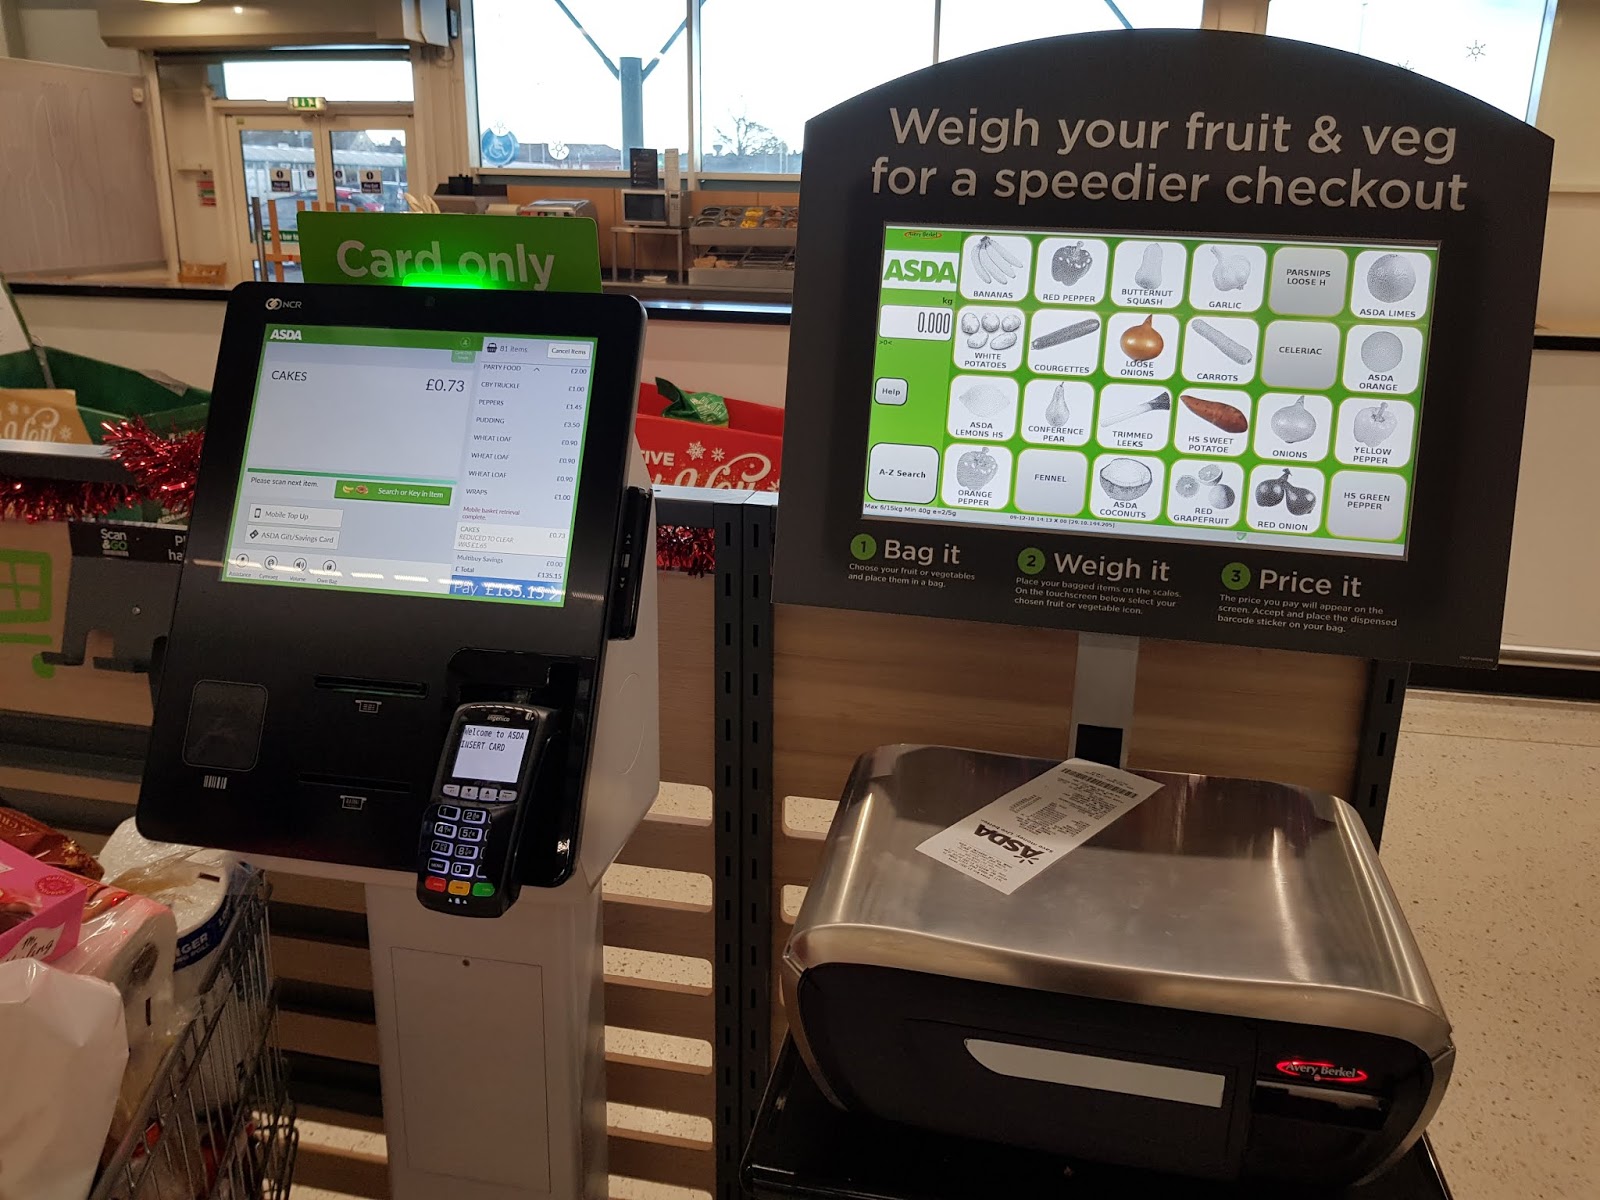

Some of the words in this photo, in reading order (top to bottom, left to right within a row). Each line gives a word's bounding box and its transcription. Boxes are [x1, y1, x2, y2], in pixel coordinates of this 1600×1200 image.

[889, 107, 1040, 154] Weigh
[1056, 119, 1169, 155] your
[1185, 111, 1292, 153] fruit
[1307, 115, 1343, 154] &
[1361, 125, 1457, 165] veg
[871, 156, 938, 196] for
[951, 167, 977, 197] a
[993, 162, 1210, 206] speedier
[1225, 166, 1468, 211] checkout
[336, 239, 443, 279] Card
[457, 243, 555, 292] only
[883, 258, 957, 284] ASDA
[1286, 268, 1331, 278] PARSNIPS
[1287, 278, 1317, 286] LOOSE
[973, 290, 1013, 299] BANANAS
[1121, 288, 1173, 297] BUTTERNUT
[942, 297, 953, 306] kg
[1042, 293, 1060, 301] RED
[1062, 294, 1096, 303] PEPPER
[1126, 297, 1163, 306] SQUASH
[282, 300, 302, 309] NCR
[1208, 300, 1242, 309] GARLIC
[1359, 308, 1386, 317] ASDA
[1388, 309, 1416, 318] LIMES
[917, 311, 951, 335] 0.000
[269, 328, 303, 341] ASDA
[1278, 346, 1323, 355] CELERIAC
[974, 352, 1001, 360] WHITE
[964, 360, 1007, 369] POTATOES
[1034, 364, 1090, 374] COURGETTES
[1125, 360, 1154, 369] LOOSE
[1120, 368, 1155, 378] ONIONS
[1196, 372, 1239, 382] CARROTS
[1367, 374, 1394, 382] ASDA
[271, 370, 307, 382] CAKES
[426, 378, 465, 393] £0.73
[1358, 382, 1398, 391] ORANGE
[881, 388, 901, 396] Help
[969, 421, 993, 429] ASDA
[1028, 425, 1085, 435] CONFERENCE
[473, 434, 496, 442] WHEAT
[955, 429, 990, 438] LEMONS
[992, 431, 1004, 439] HS
[1042, 434, 1065, 443] PEAR
[1112, 430, 1153, 440] TRIMMED
[1116, 439, 1144, 448] LEEKS
[1187, 435, 1201, 444] HS
[1203, 436, 1235, 445] SWEET
[1188, 444, 1229, 454] POTATOE
[1354, 446, 1392, 456] YELLOW
[471, 452, 493, 460] WHEAT
[1272, 450, 1308, 459] ONIONS
[1353, 455, 1388, 465] PEPPER
[468, 470, 491, 478] WHEAT
[878, 468, 895, 477] A-Z
[896, 469, 926, 479] Search
[1034, 473, 1067, 483] FENNEL
[250, 476, 270, 486] Please
[378, 487, 399, 496] Search
[408, 489, 421, 498] Key
[957, 489, 993, 499] ORANGE
[1343, 491, 1357, 500] HS
[1359, 492, 1391, 502] GREEN
[957, 498, 990, 507] PEPPER
[1113, 501, 1138, 509] ASDA
[1347, 501, 1383, 510] PEPPER
[265, 510, 286, 519] Mobile
[1099, 508, 1147, 519] COCONUTS
[1194, 507, 1213, 515] RED
[1173, 514, 1230, 525] GRAPEFRUIT
[1257, 521, 1276, 530] RED
[1278, 522, 1308, 531] ONION
[100, 528, 127, 540] Scan
[261, 532, 280, 540] ASDA
[280, 533, 318, 543] Gift/Savings
[318, 535, 334, 543] Card
[884, 539, 934, 566] Bag
[943, 543, 961, 564] it
[849, 563, 879, 572] Choose
[880, 567, 898, 575] your
[900, 567, 918, 575] fruit
[930, 570, 975, 581] vegetables
[1026, 555, 1036, 567] 2
[1053, 552, 1141, 581] Weigh
[1151, 559, 1170, 582] it
[848, 573, 864, 581] and
[864, 574, 887, 583] place
[888, 576, 910, 584] them
[927, 578, 946, 588] bag.
[1231, 569, 1241, 582] 3
[1259, 568, 1332, 595] Price
[1342, 575, 1362, 598] it
[1016, 577, 1039, 586] Place
[1040, 580, 1060, 589] your
[1062, 581, 1095, 591] bagged
[1097, 584, 1121, 593] items
[1152, 588, 1182, 598] scales.
[1045, 589, 1098, 601] touchscreen
[1100, 593, 1126, 603] below
[1128, 596, 1154, 606] select
[1156, 600, 1176, 609] your
[1219, 594, 1237, 603] The
[1238, 596, 1262, 606] price
[1263, 599, 1281, 608] you
[1282, 601, 1300, 610] pay
[1301, 601, 1318, 610] will
[1319, 603, 1352, 614] appear
[1014, 597, 1044, 607] chosen
[1046, 599, 1065, 608] fruit
[1077, 603, 1121, 613] vegetable
[1122, 606, 1143, 615] icon.
[1218, 606, 1250, 615] screen.
[1252, 607, 1285, 619] Accept
[1286, 610, 1305, 619] and
[1306, 611, 1331, 622] place
[1350, 615, 1398, 627] dispensed
[1217, 614, 1255, 625] barcode
[1256, 617, 1287, 628] sticker
[1303, 622, 1324, 633] your
[1325, 623, 1347, 634] bag.
[463, 726, 493, 738] Welcome
[496, 730, 505, 739] to
[507, 730, 525, 740] ASDA
[460, 740, 486, 750] INSERT
[488, 742, 506, 752] CARD
[465, 811, 473, 820] 2
[461, 829, 469, 838] 5
[973, 823, 1047, 859] ASDA
[458, 847, 465, 856] 8
[1285, 1062, 1318, 1076] Avery
[1320, 1065, 1357, 1078] Berkel
